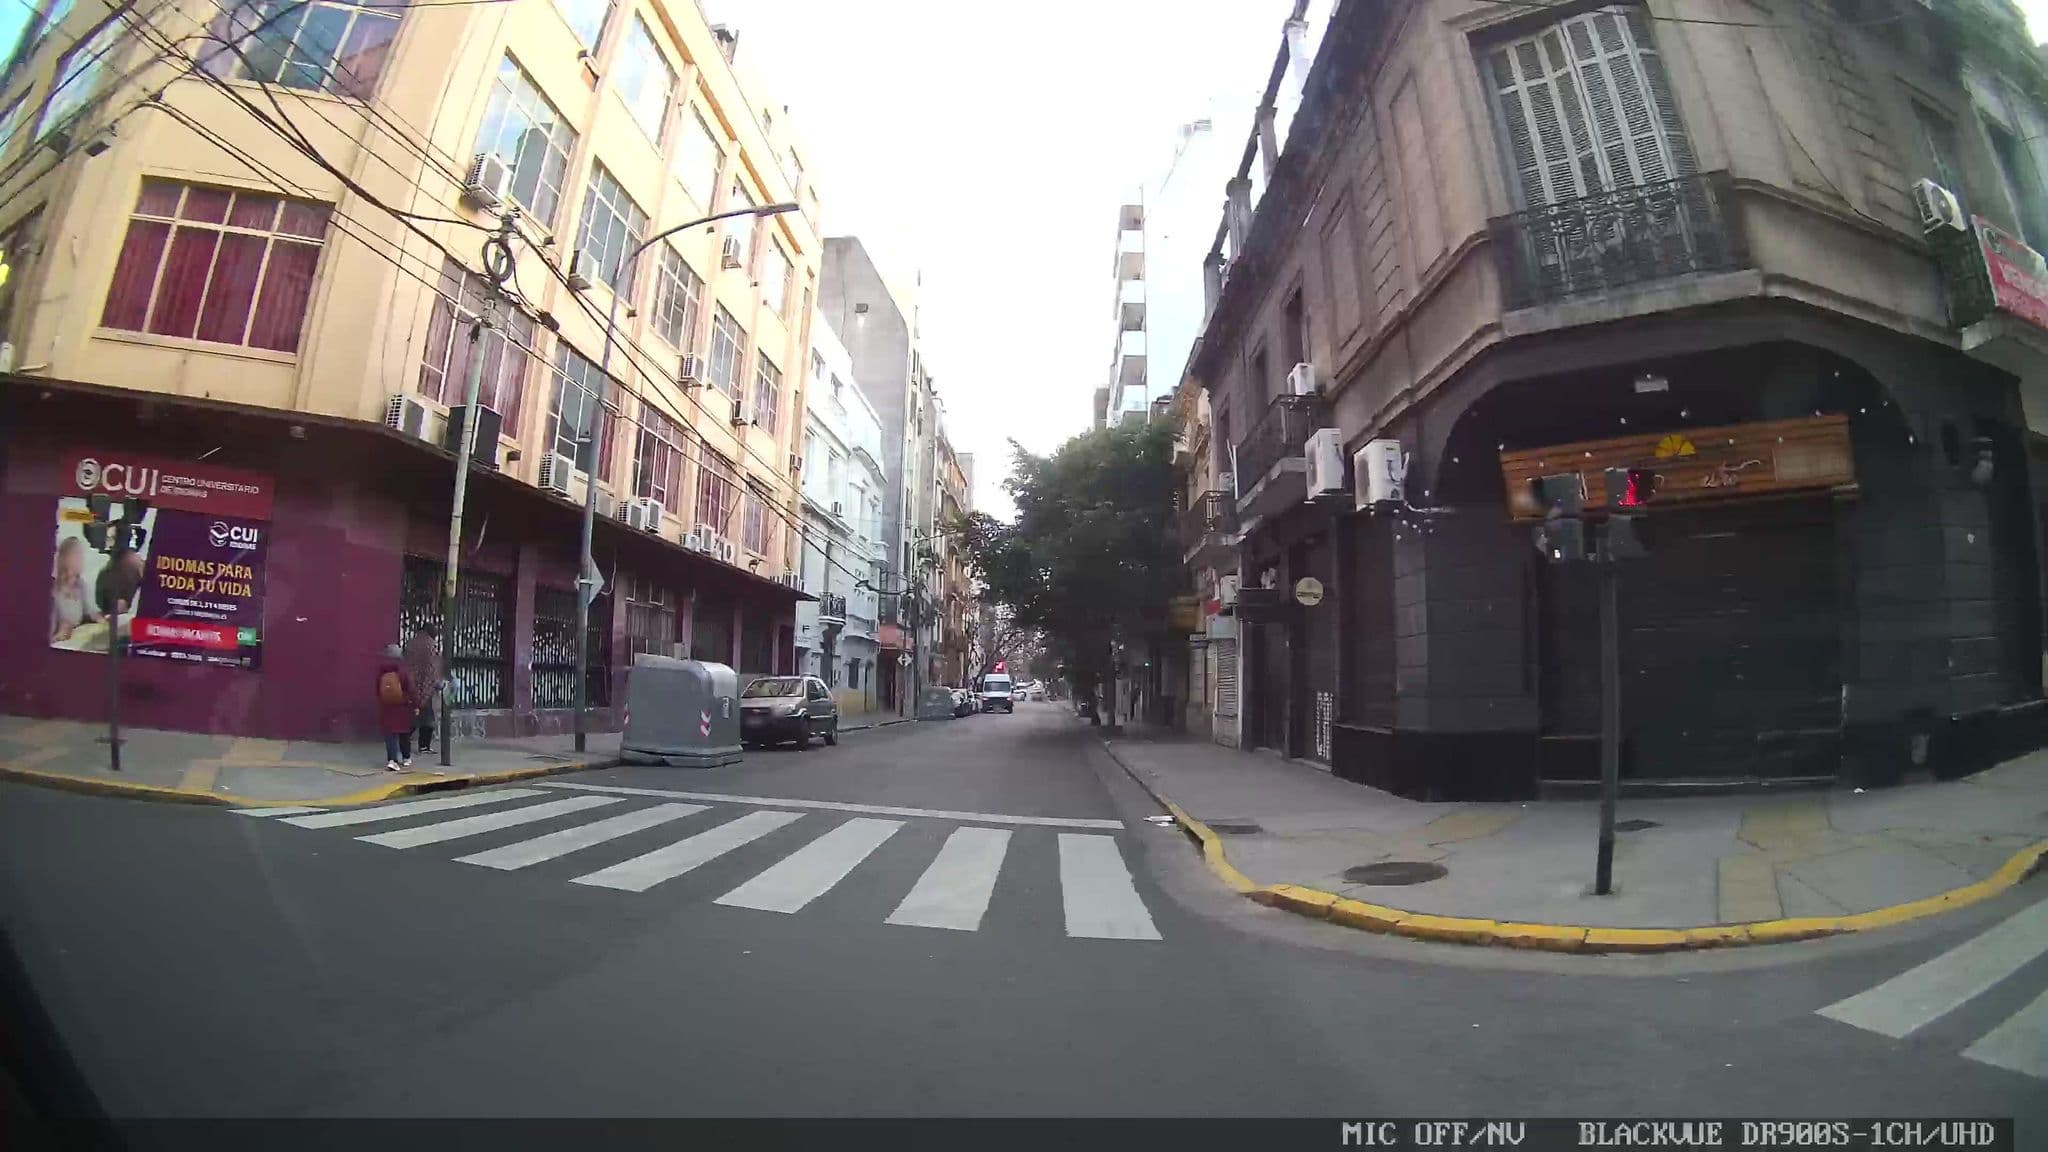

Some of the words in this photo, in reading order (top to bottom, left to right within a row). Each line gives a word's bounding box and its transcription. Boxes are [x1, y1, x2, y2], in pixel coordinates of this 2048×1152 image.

[102, 463, 158, 496] CUI
[161, 475, 196, 486] CENTRO
[196, 479, 259, 494] UNIVERSITARIO
[230, 526, 258, 543] CUI
[156, 555, 215, 576] IDIOMAS
[217, 563, 253, 580] PARA
[158, 574, 195, 591] TODA
[198, 579, 216, 593] TU
[218, 581, 252, 597] VIDA
